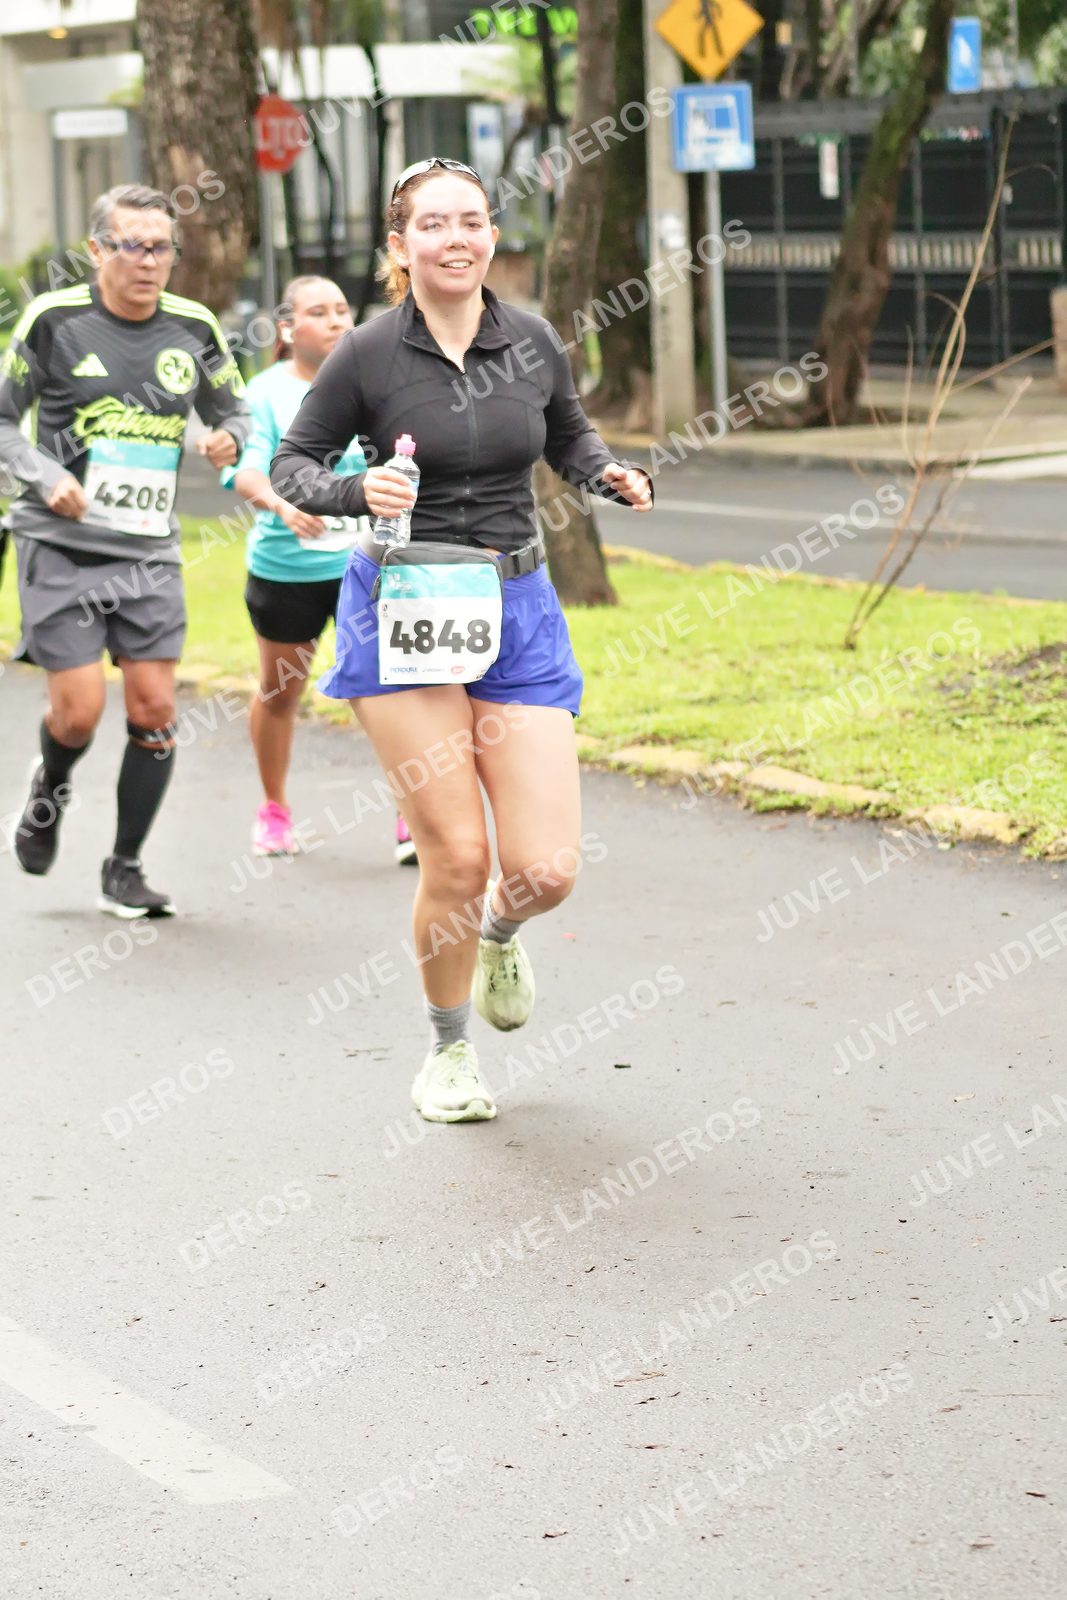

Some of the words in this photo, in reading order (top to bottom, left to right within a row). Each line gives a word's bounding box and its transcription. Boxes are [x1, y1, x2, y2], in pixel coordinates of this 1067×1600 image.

[256, 115, 309, 150] LTO
[94, 481, 168, 512] 4208
[390, 619, 492, 654] 4848
